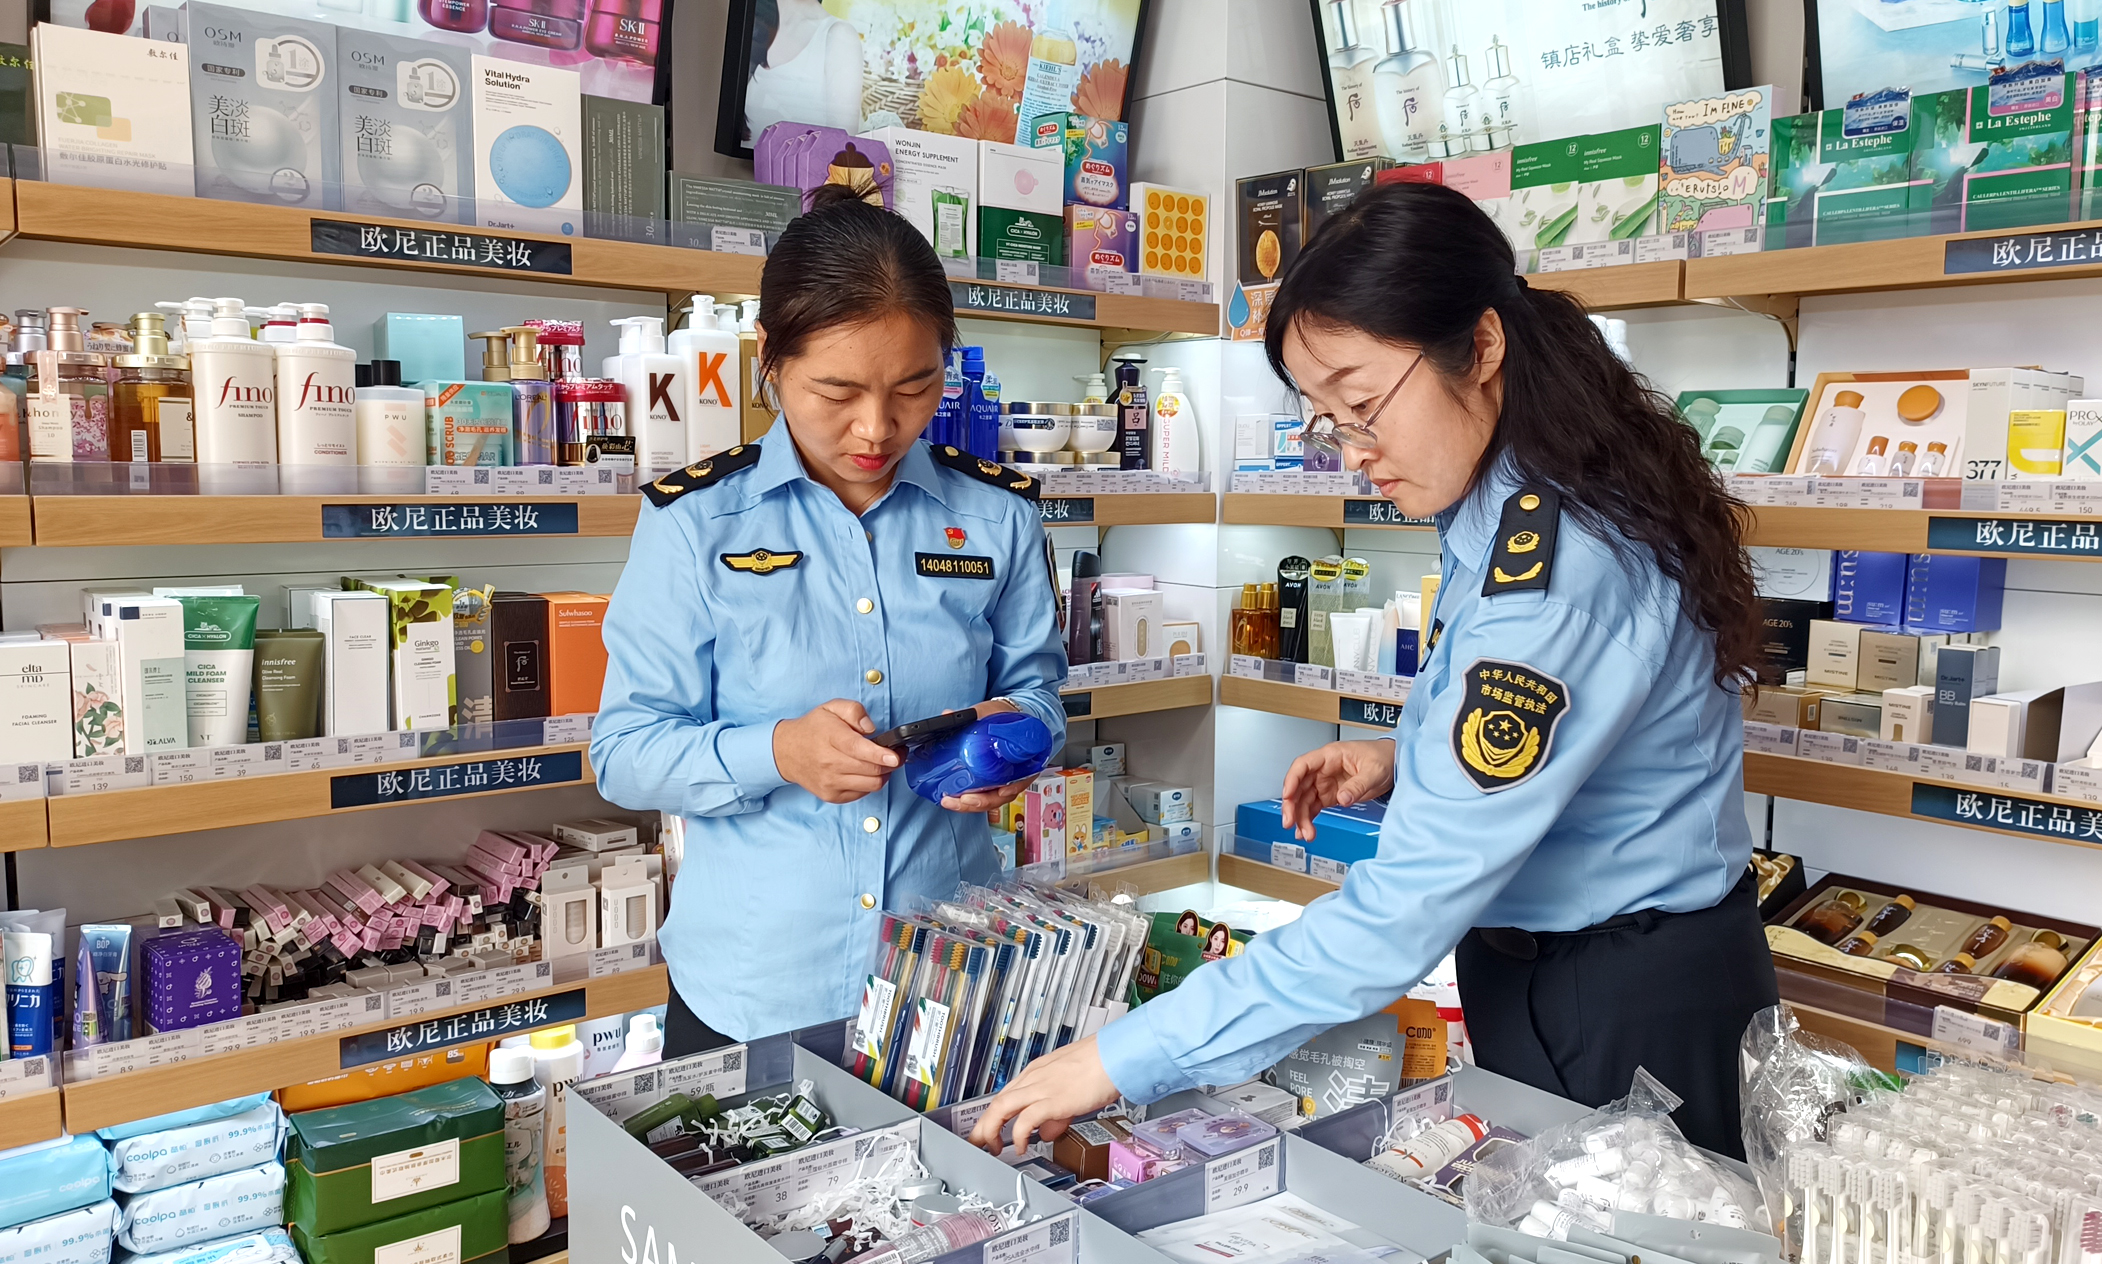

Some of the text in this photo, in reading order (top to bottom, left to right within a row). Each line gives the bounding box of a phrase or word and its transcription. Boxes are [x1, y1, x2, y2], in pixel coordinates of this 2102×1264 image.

[1582, 2, 1596, 11] The
[205, 27, 242, 42] OSM
[1540, 14, 1719, 69] 镇店礼盒 挚爱奢享
[351, 50, 385, 66] OSM
[206, 65, 240, 76] 国家专利
[1039, 61, 1062, 74] KIEHL'S
[485, 69, 530, 84] Vital Hydra
[485, 78, 521, 90] Solution
[353, 86, 384, 98] 国家专利
[1987, 111, 2052, 129] La Estephe
[895, 139, 921, 149] WONJIN
[1640, 134, 1649, 145] 12
[1835, 135, 1893, 151] La Estephe
[895, 148, 959, 163] ENERGY SUPPLEMENT
[1569, 144, 1577, 153] 12
[59, 152, 167, 170] 敷尔佳胶原蛋白水光修护贴
[1085, 163, 1110, 173] めぐりズム
[1425, 170, 1433, 179] 12
[488, 220, 515, 229] Dr.Jart+
[360, 226, 532, 268] 欧尼正品美妆
[1095, 254, 1120, 262] めぐりズム
[968, 287, 1070, 315] 欧尼正品美妆
[699, 352, 732, 408] K
[214, 376, 273, 409] fino
[294, 371, 355, 411] fino
[649, 372, 680, 421] K
[970, 405, 998, 413] AQUAIR
[1966, 460, 2002, 480] 377
[1037, 499, 1070, 519] 美妆
[1368, 503, 1435, 524] 欧尼
[371, 504, 539, 532] 欧尼正品美妆
[1975, 520, 2099, 550] 欧尼正品
[920, 557, 989, 574] 14048110051
[558, 609, 593, 617] Sulwhasoo
[1763, 618, 1778, 627] AGE
[414, 639, 440, 648] Ginkgo
[22, 664, 42, 673] elta
[262, 658, 296, 666] innisfree
[1478, 668, 1558, 705] 中华人民共和国
[1480, 683, 1548, 715] 市场监管执法
[1939, 690, 1956, 701] BB
[1363, 703, 1397, 724] 欧尼
[374, 755, 383, 763] 69
[237, 769, 247, 777] 39
[377, 757, 543, 796] 欧尼正品美妆
[92, 782, 109, 791] 139
[1955, 793, 2102, 839] 欧尼正品美
[409, 1006, 425, 1015] 19.9
[879, 989, 892, 1033] TOOTHBRUSH
[386, 999, 549, 1052] 欧尼正品美妆
[268, 1036, 278, 1044] 29
[593, 1027, 621, 1046] pwu
[933, 1012, 945, 1057] TOOTHBRUSH
[1957, 1036, 1972, 1046] 699
[446, 1049, 460, 1059] 85
[1289, 1048, 1366, 1071] 感觉毛孔被掏空
[120, 1065, 134, 1074] 8.9
[669, 1061, 703, 1074] 欧尼进口美妆
[1289, 1069, 1309, 1084] FEEL
[690, 1083, 715, 1096] 59/瓶
[1290, 1084, 1313, 1098] PORE
[606, 1108, 618, 1117] 44
[228, 1126, 257, 1139] 99.9%
[126, 1149, 167, 1163] coolpa
[798, 1149, 834, 1164] 欧尼进口美妆
[744, 1164, 782, 1180] 欧尼进口美妆
[1212, 1158, 1241, 1174] 欧尼进口美妆
[59, 1174, 100, 1193] coolpa
[828, 1176, 839, 1187] 79
[775, 1191, 788, 1202] 38
[1234, 1183, 1248, 1196] 29.9
[238, 1192, 267, 1203] 99.9%
[135, 1211, 176, 1226] coolpa
[62, 1231, 95, 1247] 99.9%
[992, 1234, 1028, 1253] 欧尼进口美妆
